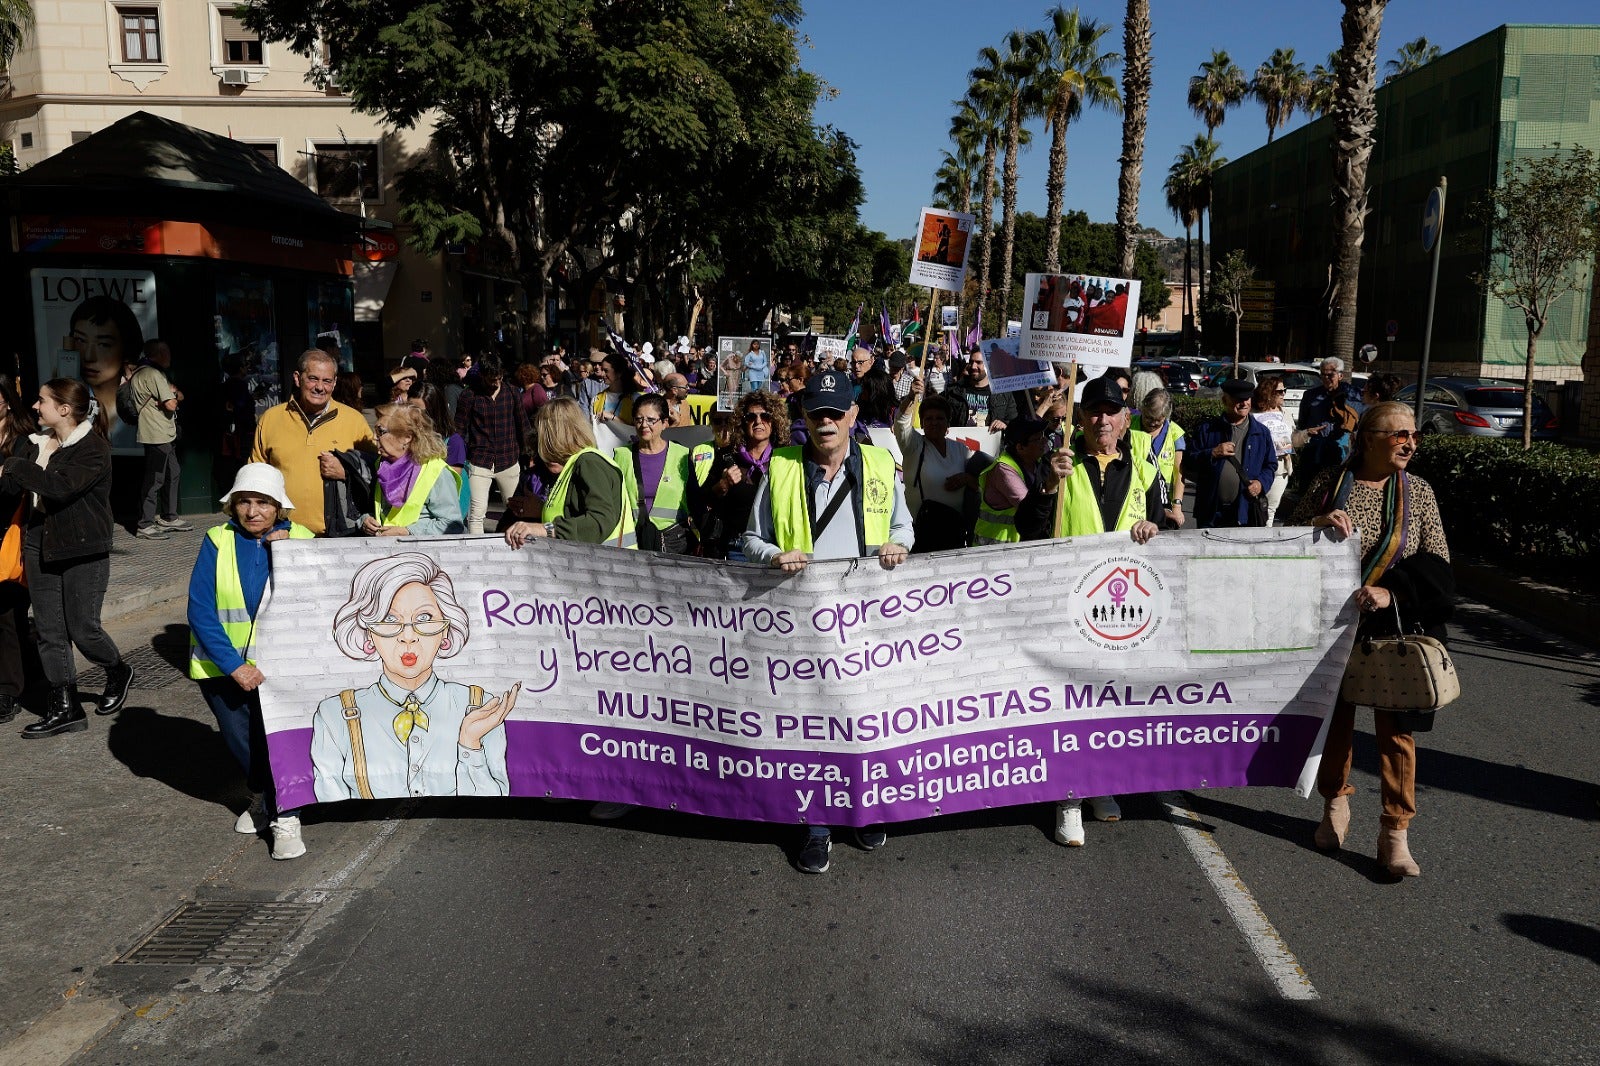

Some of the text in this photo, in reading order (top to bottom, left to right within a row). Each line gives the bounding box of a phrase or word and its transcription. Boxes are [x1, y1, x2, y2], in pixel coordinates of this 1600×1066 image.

[42, 276, 146, 303] LOEWE
[482, 574, 1012, 644] Rompamos muros opresores
[526, 628, 962, 696] y brecha de pensiones
[597, 680, 1232, 742] MUJERES PENSIONISTAS MÁLAGA
[580, 720, 1280, 786] Contra la pobreza, la violencia, la cosificación
[796, 758, 1048, 812] y la desigualdad
